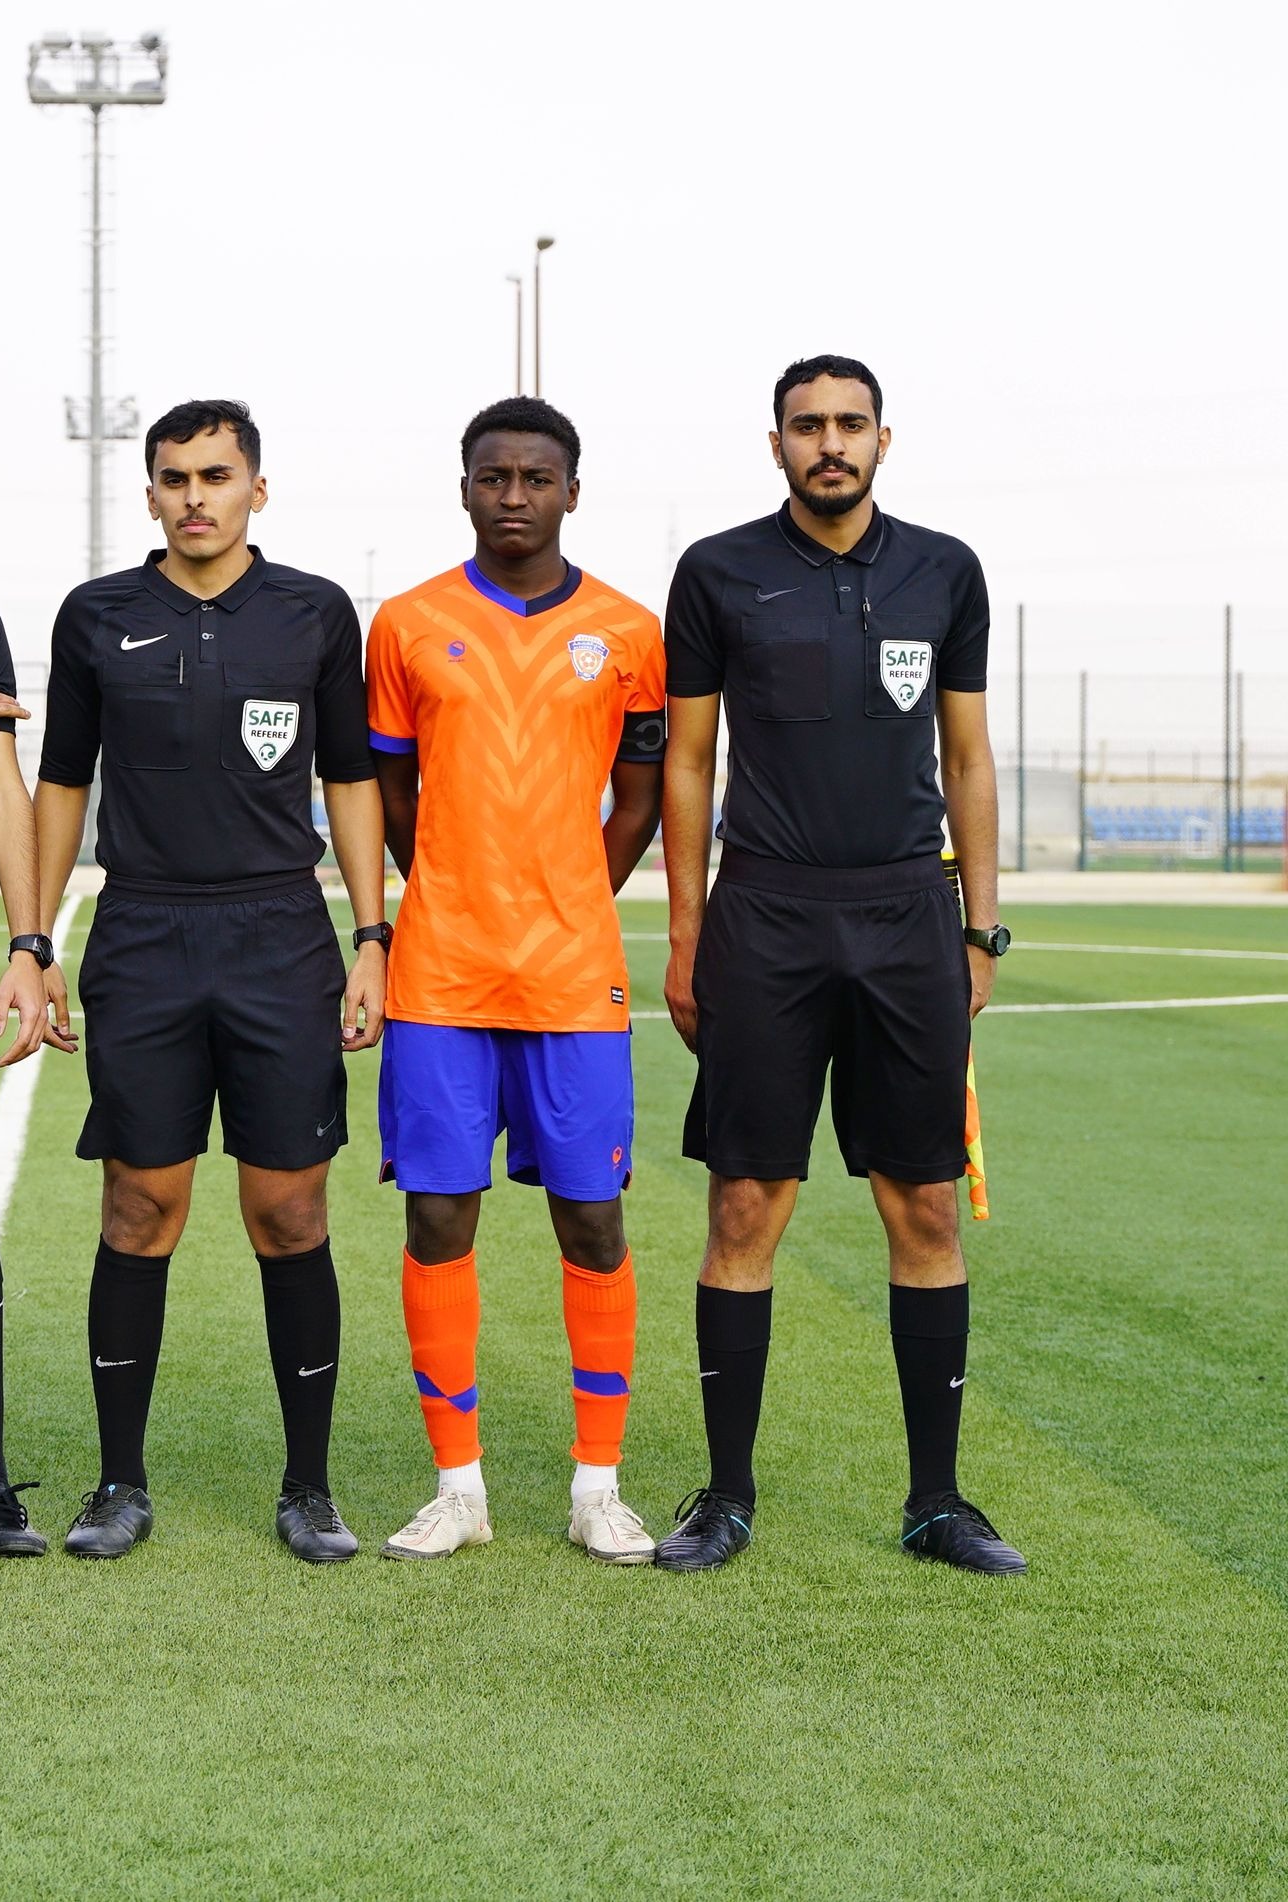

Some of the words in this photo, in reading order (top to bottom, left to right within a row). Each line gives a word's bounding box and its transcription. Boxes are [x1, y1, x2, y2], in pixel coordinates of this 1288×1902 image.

[885, 650, 928, 666] SAFF
[889, 670, 923, 679] REFEREE
[248, 709, 295, 727] SAFF
[250, 729, 288, 740] REFEREE
